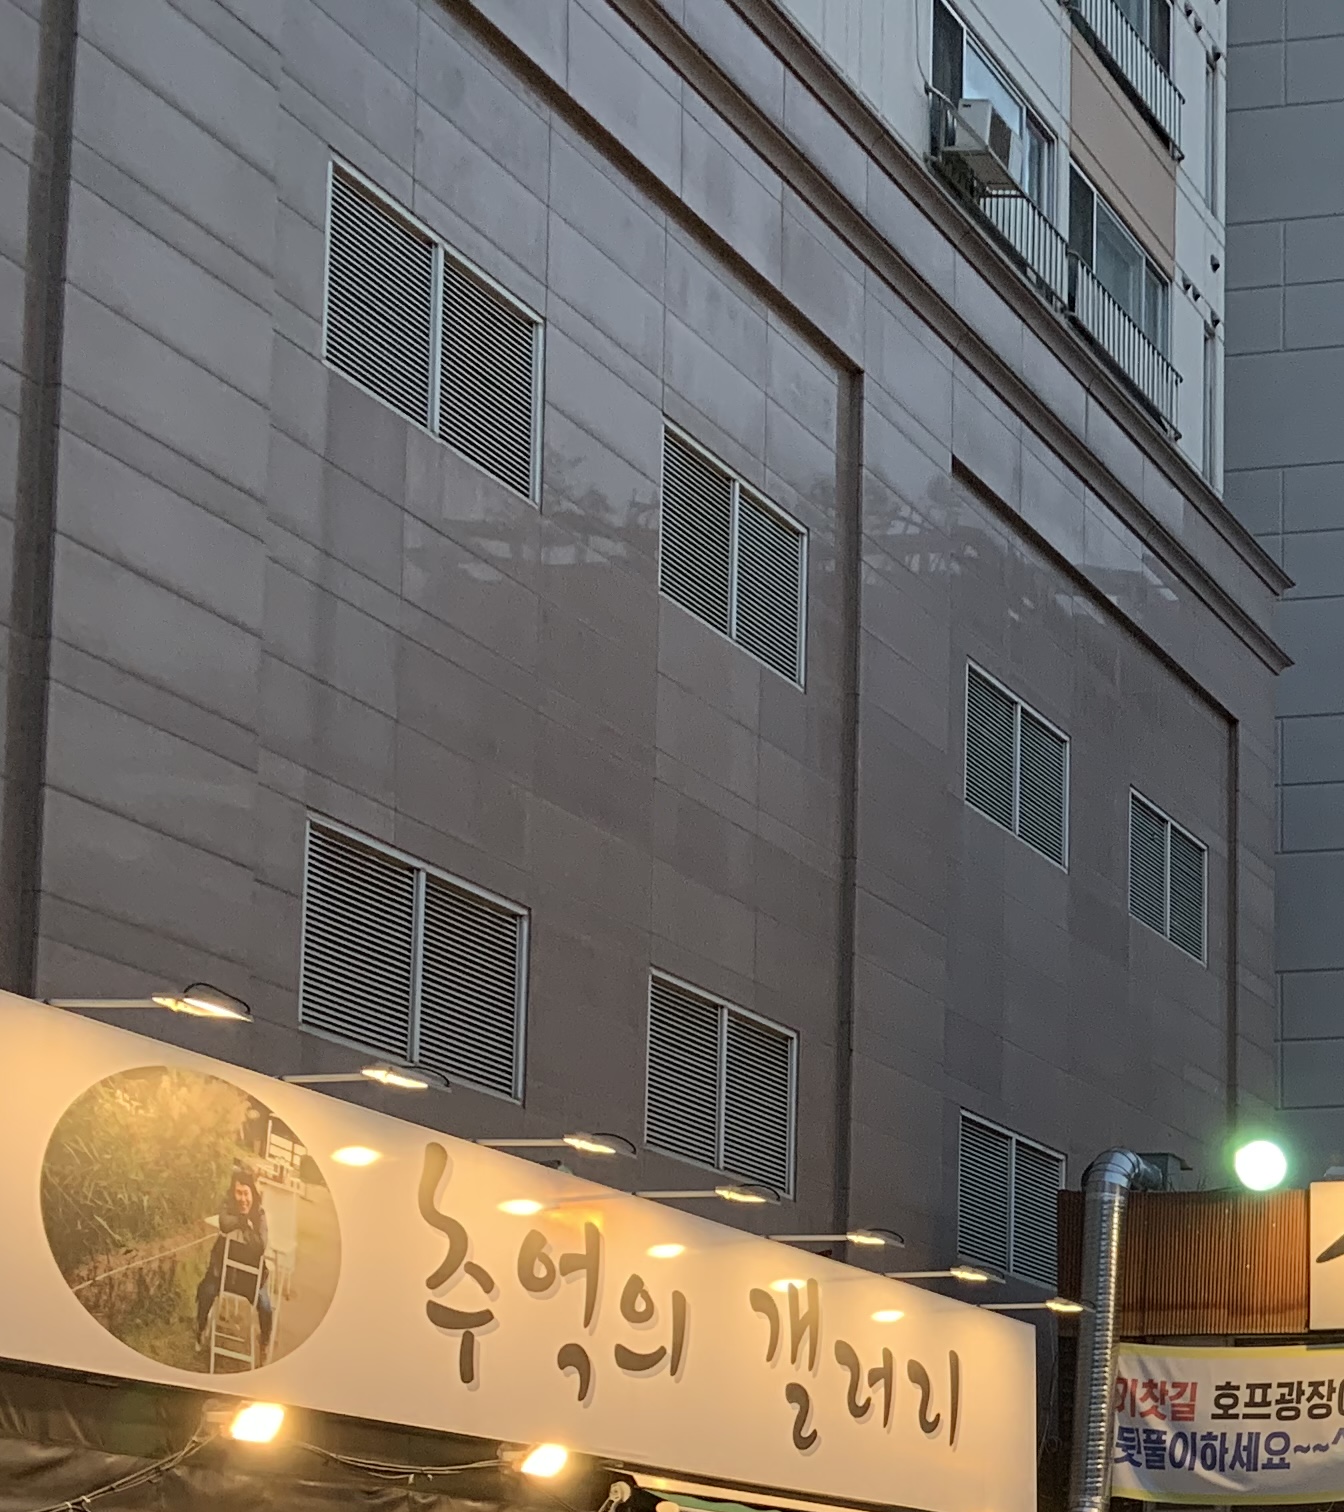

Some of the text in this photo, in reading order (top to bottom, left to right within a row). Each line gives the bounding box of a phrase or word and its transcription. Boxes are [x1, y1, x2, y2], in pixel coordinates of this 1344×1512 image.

[415, 1138, 962, 1453] 추억의 갤러리
[1114, 1376, 1199, 1422] 기찻길
